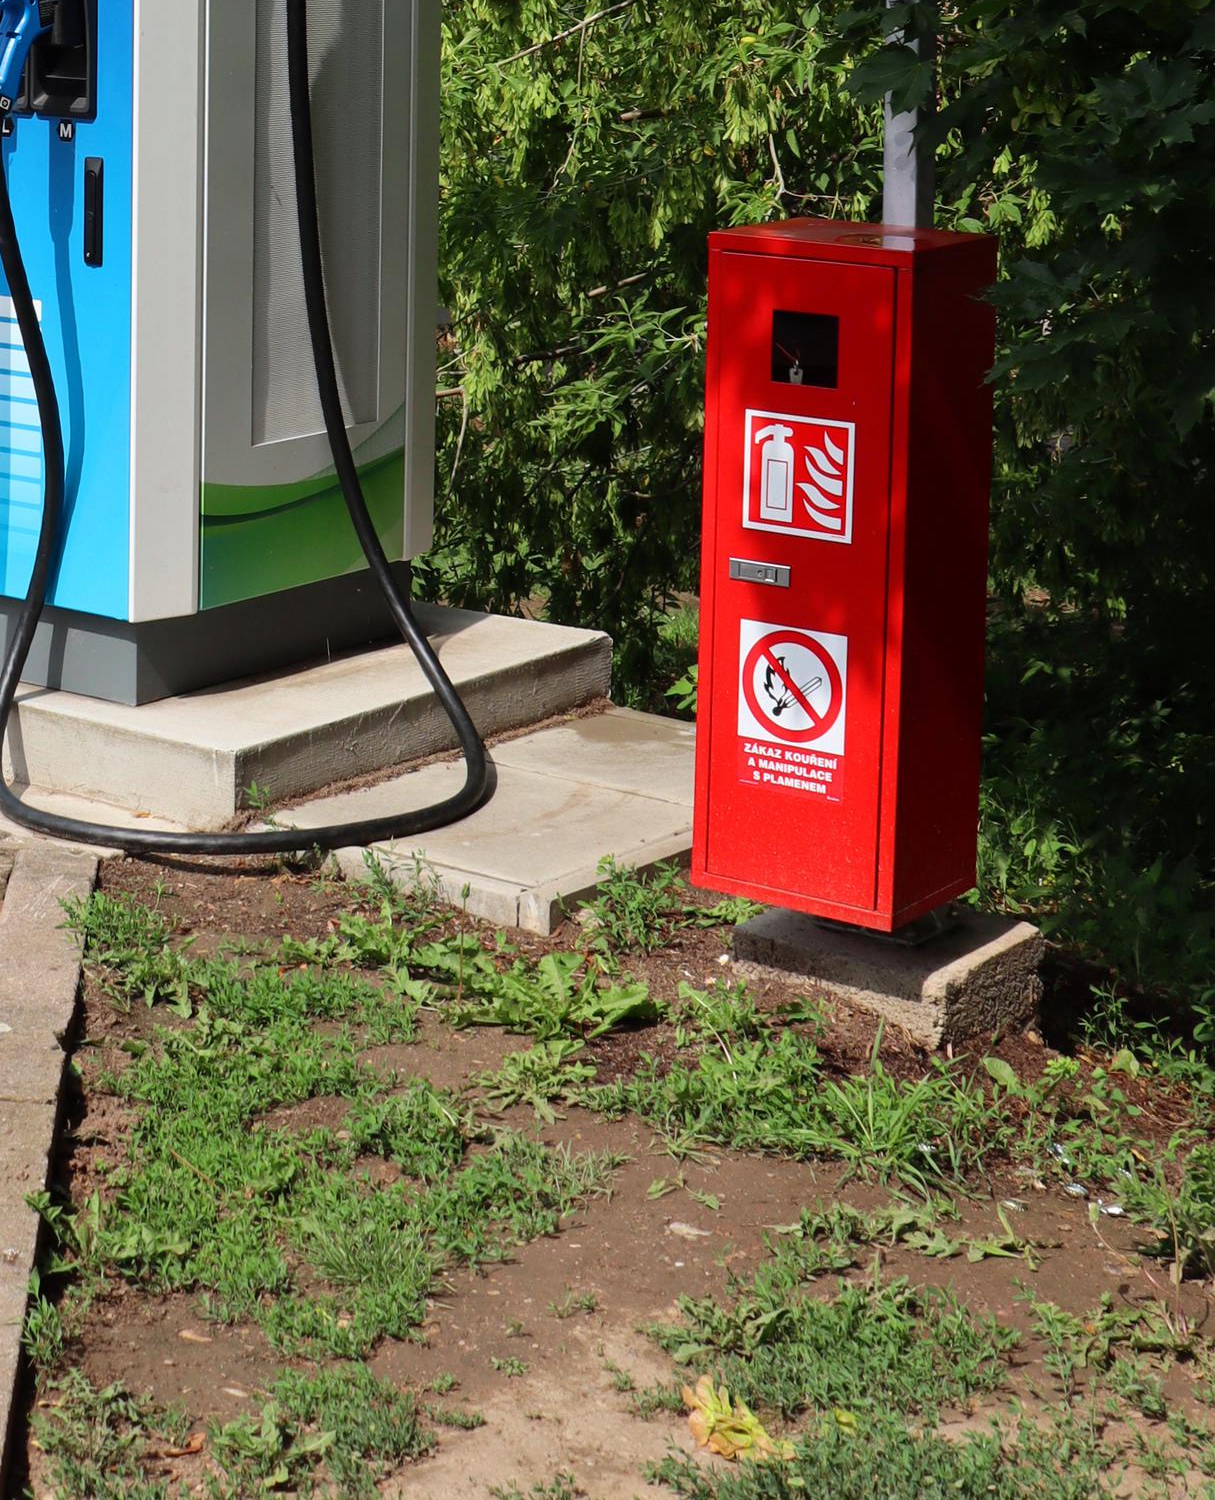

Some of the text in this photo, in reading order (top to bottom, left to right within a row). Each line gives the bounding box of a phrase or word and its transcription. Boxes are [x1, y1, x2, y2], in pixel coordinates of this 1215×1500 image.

[1, 118, 10, 133] L
[59, 122, 73, 139] M
[743, 742, 838, 770] ZÁKAZ KOUŘENÍ
[747, 756, 833, 782] A MANIPULACE
[752, 770, 826, 794] S PLAMENEM
